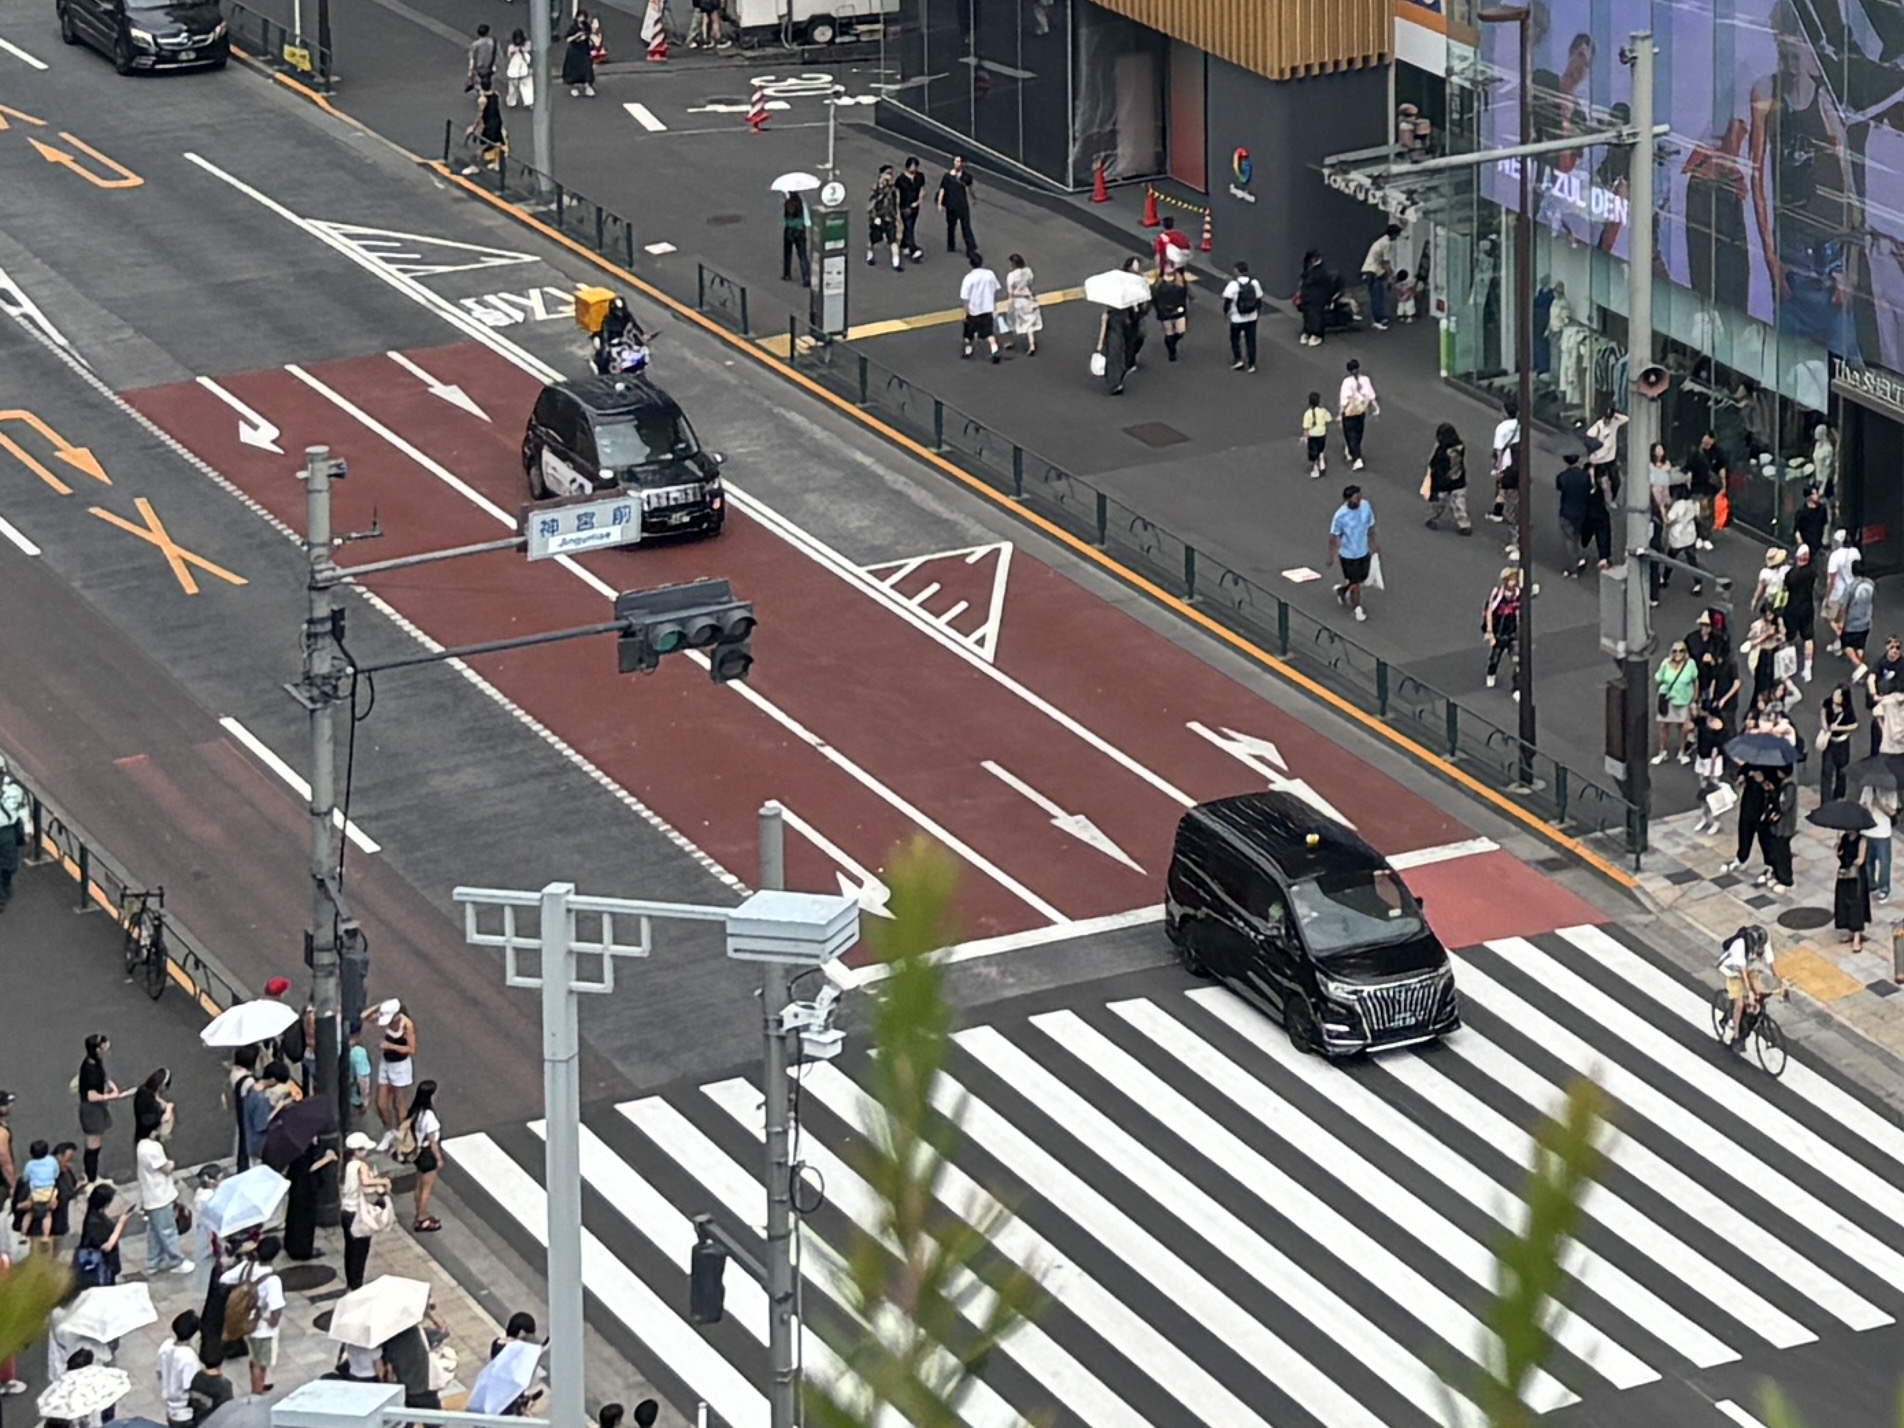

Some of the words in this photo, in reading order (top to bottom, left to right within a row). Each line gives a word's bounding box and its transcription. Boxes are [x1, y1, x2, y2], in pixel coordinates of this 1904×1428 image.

[1541, 166, 1587, 208] AZUL
[540, 505, 632, 538] 神宮前
